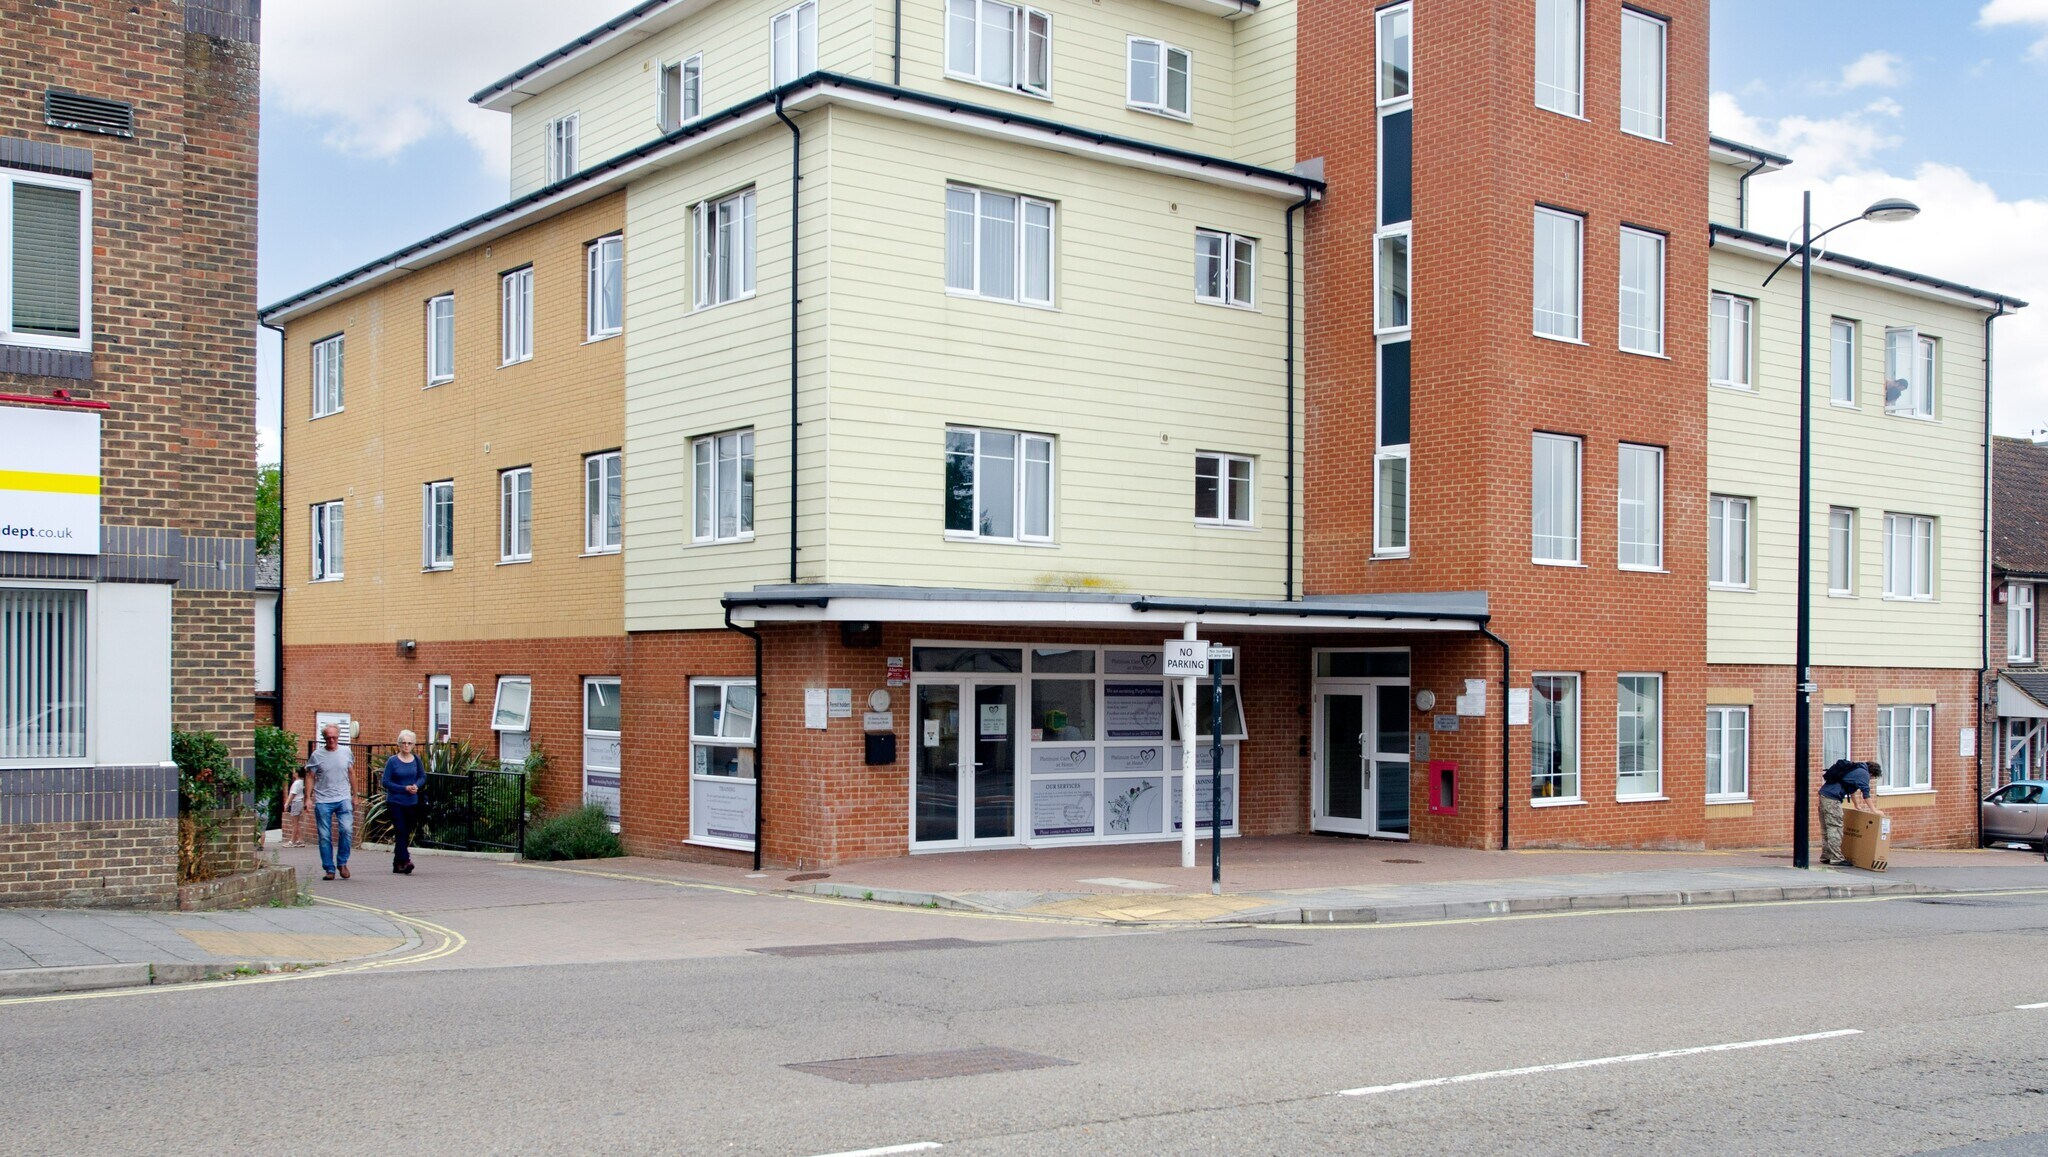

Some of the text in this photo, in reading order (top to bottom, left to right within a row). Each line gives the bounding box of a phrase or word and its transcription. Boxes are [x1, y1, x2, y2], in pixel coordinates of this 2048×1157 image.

[0, 525, 72, 539] dept.co.uk
[1180, 648, 1193, 656] NO
[1167, 659, 1204, 669] PARKING
